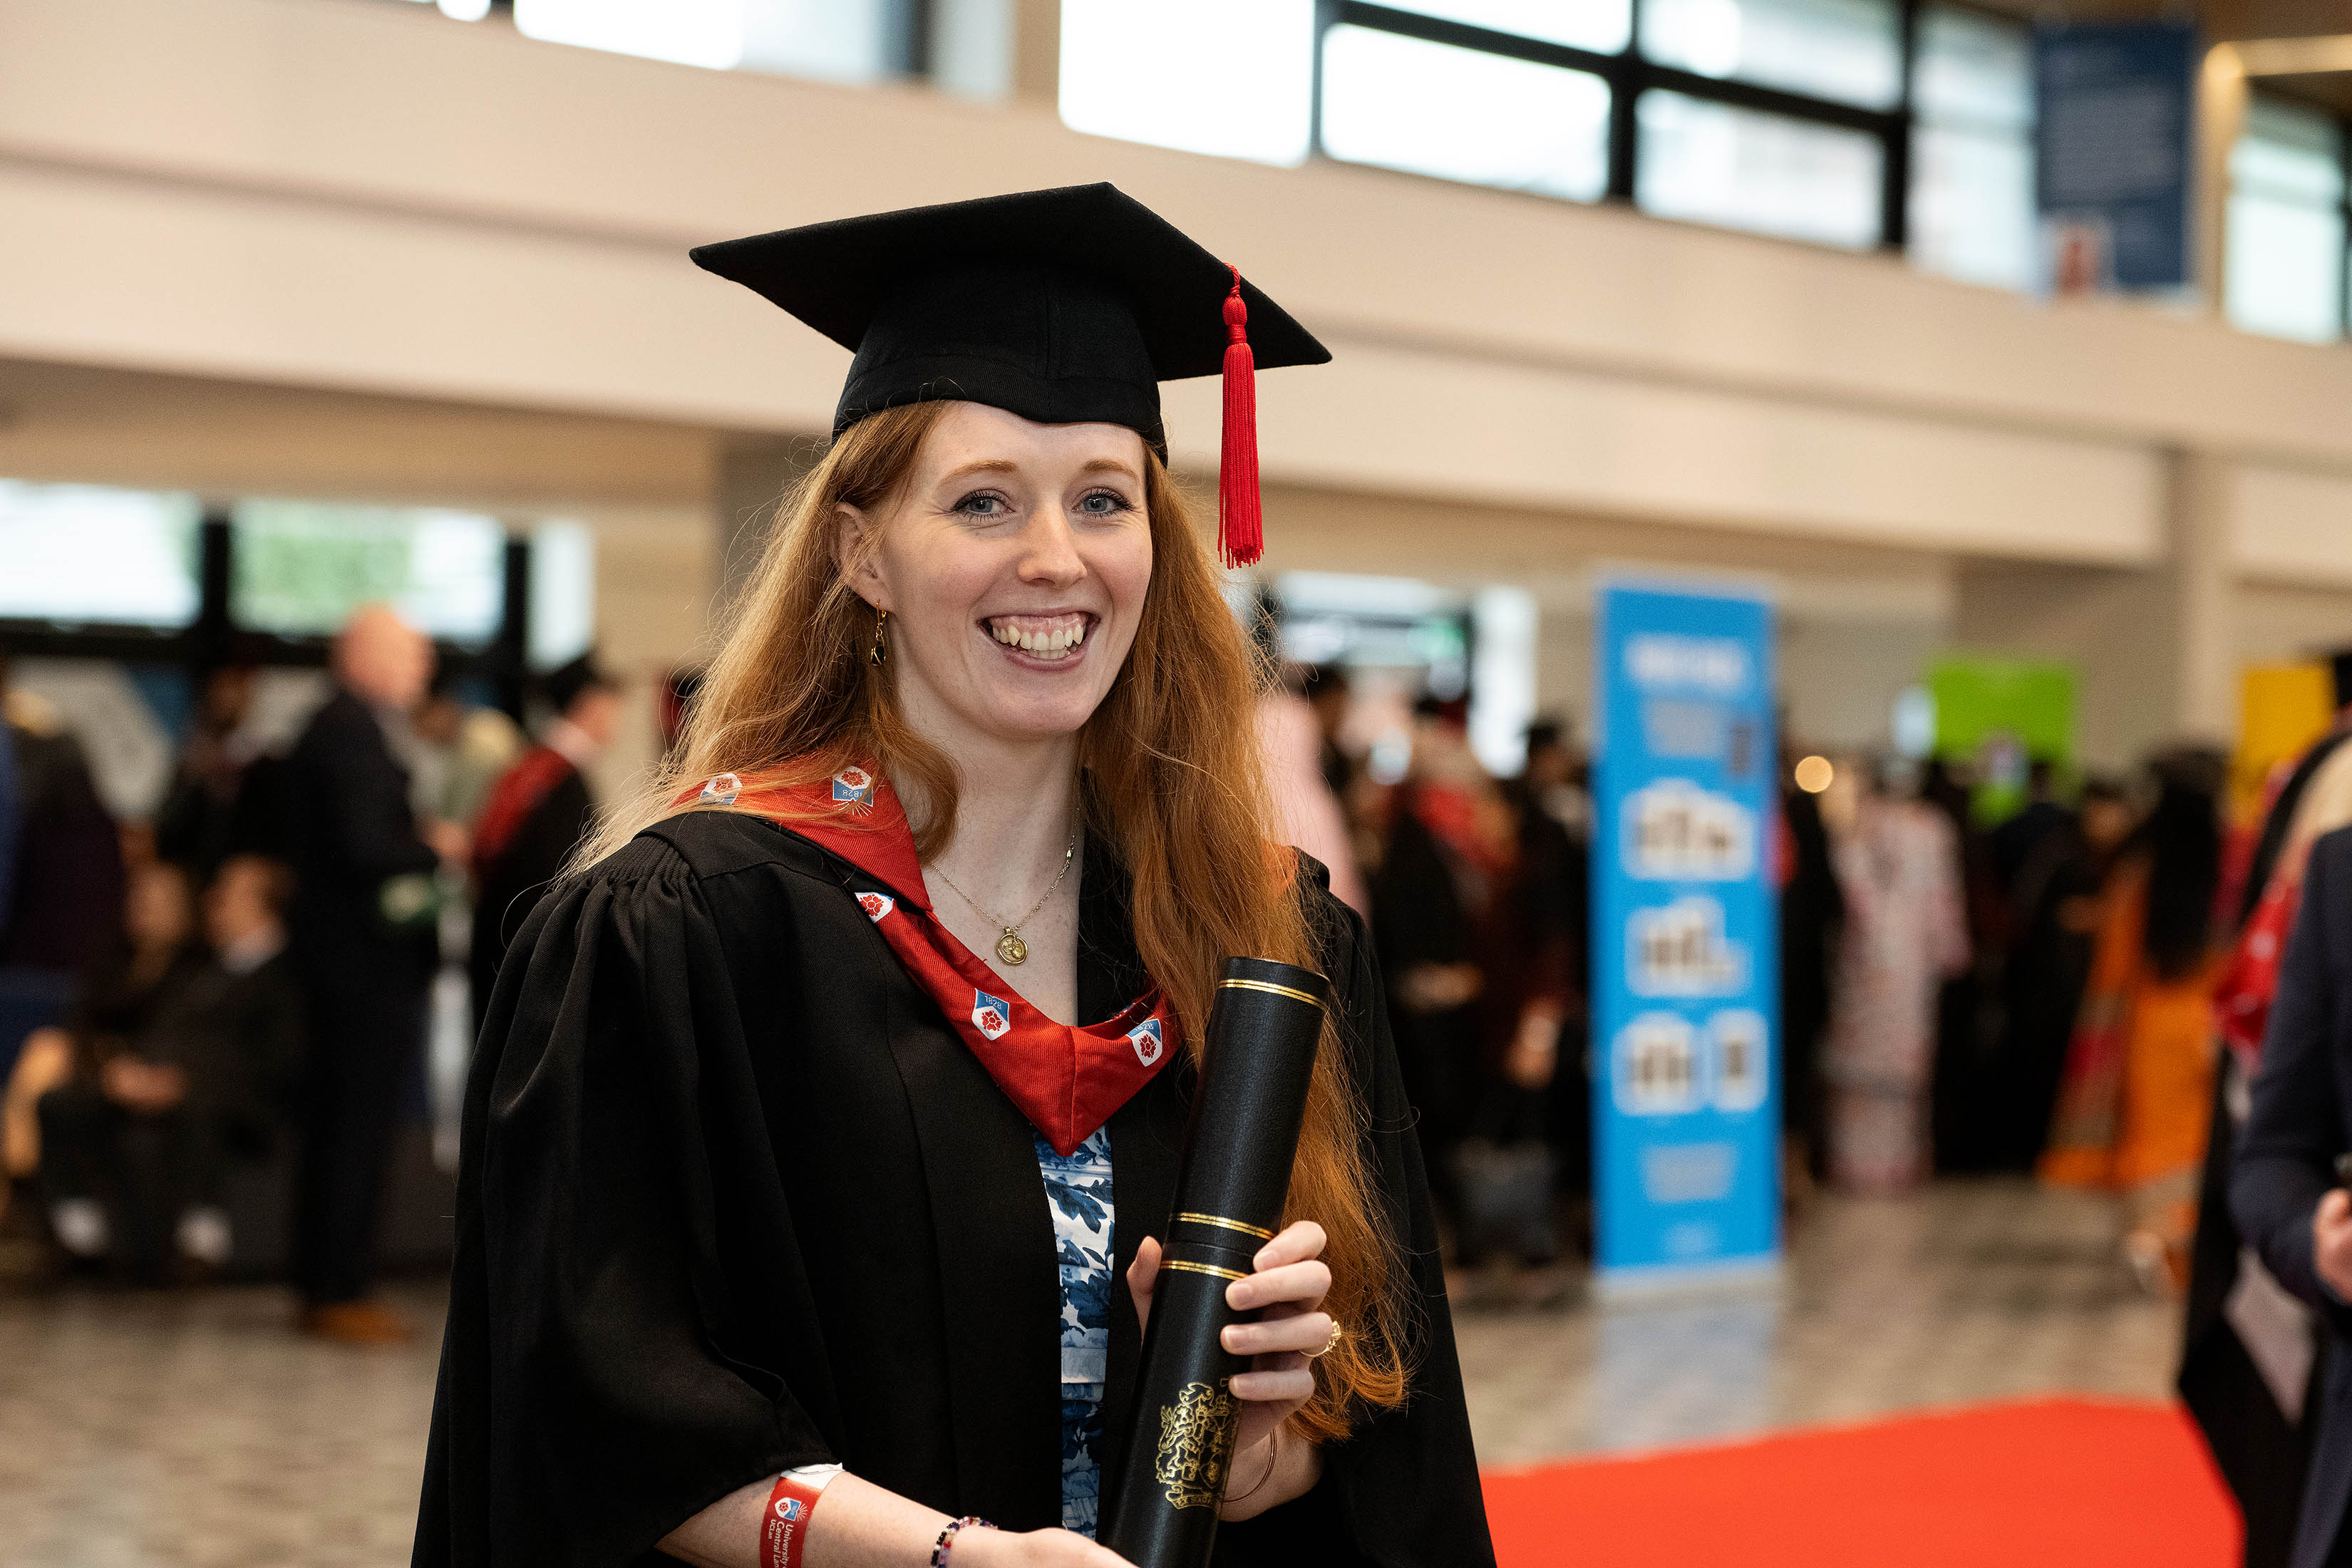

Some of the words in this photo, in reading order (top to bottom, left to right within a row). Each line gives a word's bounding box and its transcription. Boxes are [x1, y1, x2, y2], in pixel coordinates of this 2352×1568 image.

[984, 996, 1001, 1009] 1828
[773, 1522, 785, 1554] Central
[780, 1525, 793, 1566] University
